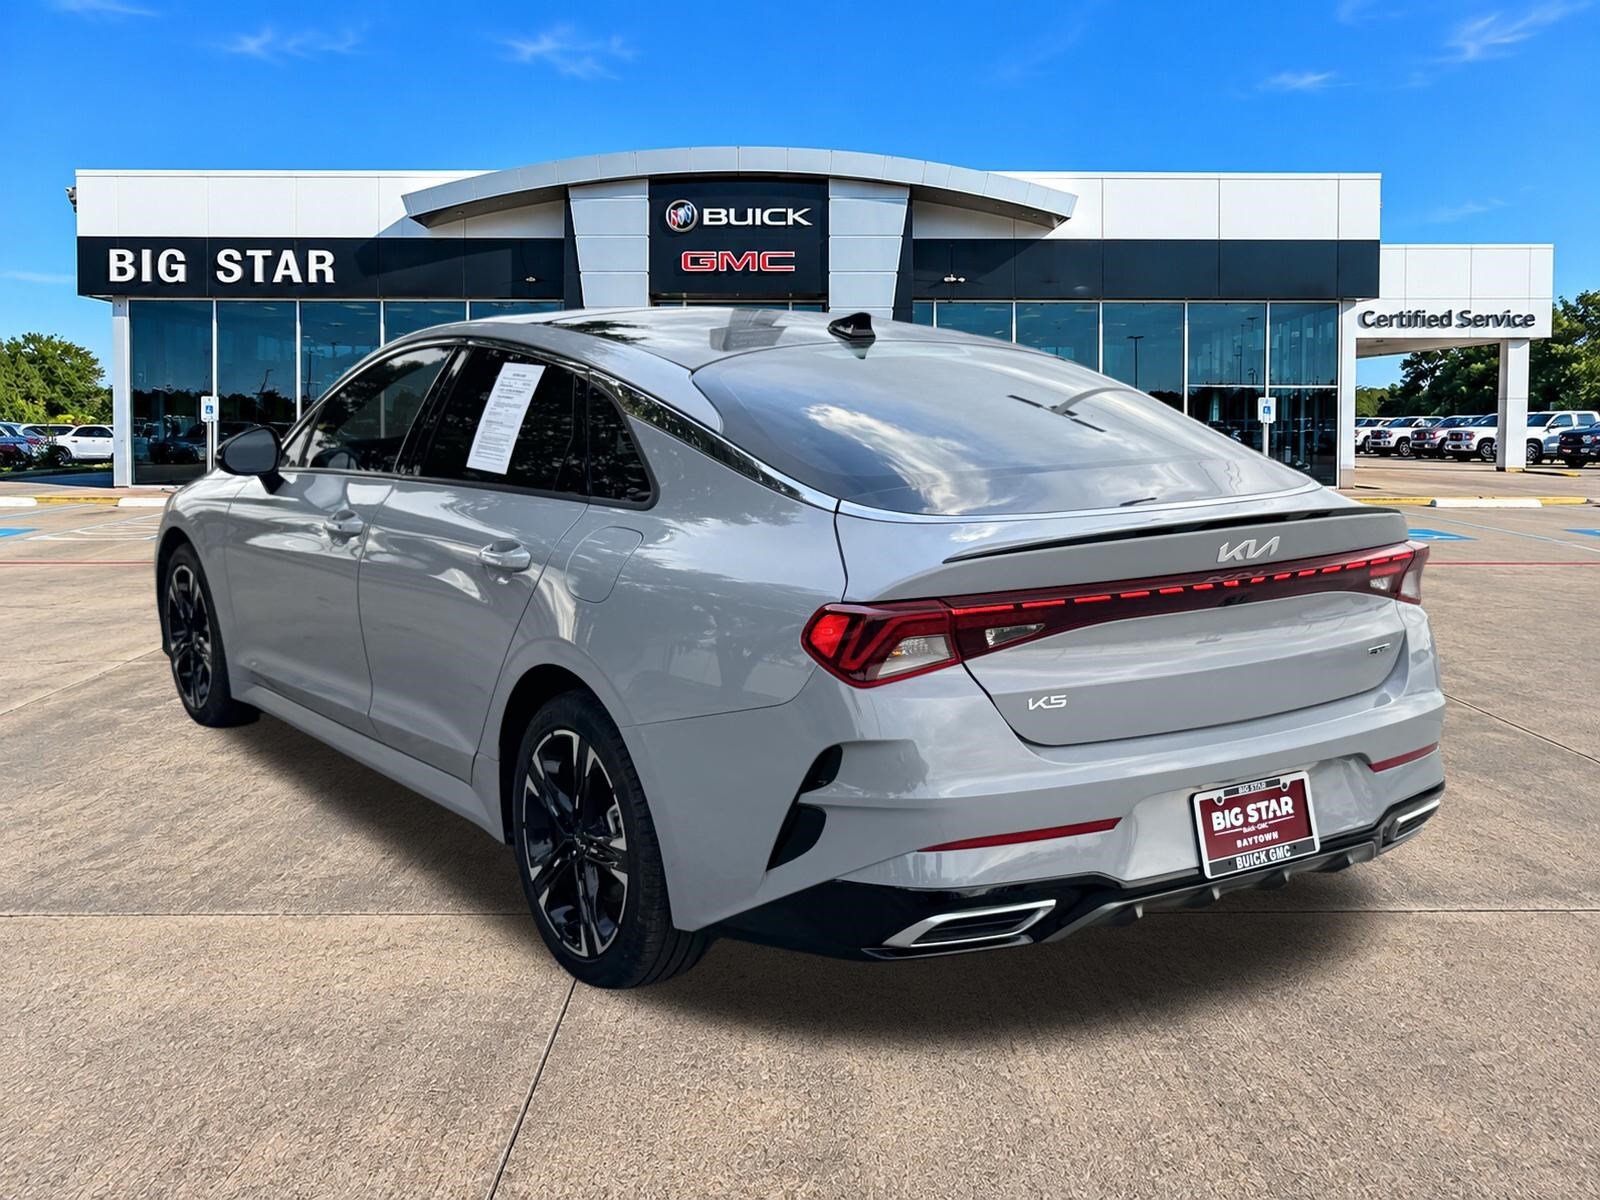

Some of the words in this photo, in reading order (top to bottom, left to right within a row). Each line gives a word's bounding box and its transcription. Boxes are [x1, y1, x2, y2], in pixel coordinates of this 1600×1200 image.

[703, 208, 813, 226] BUICK
[108, 248, 187, 283] BIG
[216, 248, 336, 284] STAR
[681, 250, 796, 272] GMC
[1361, 310, 1453, 328] Certified
[1457, 310, 1536, 328] Service
[1028, 695, 1067, 710] K5
[1238, 785, 1250, 794] BIG
[1250, 781, 1267, 791] STAR
[1211, 807, 1244, 831] BIG
[1246, 796, 1294, 823] STAR
[1236, 831, 1279, 848] BAYTOWN
[1235, 849, 1269, 869] BUICK
[1268, 845, 1291, 860] GMC
